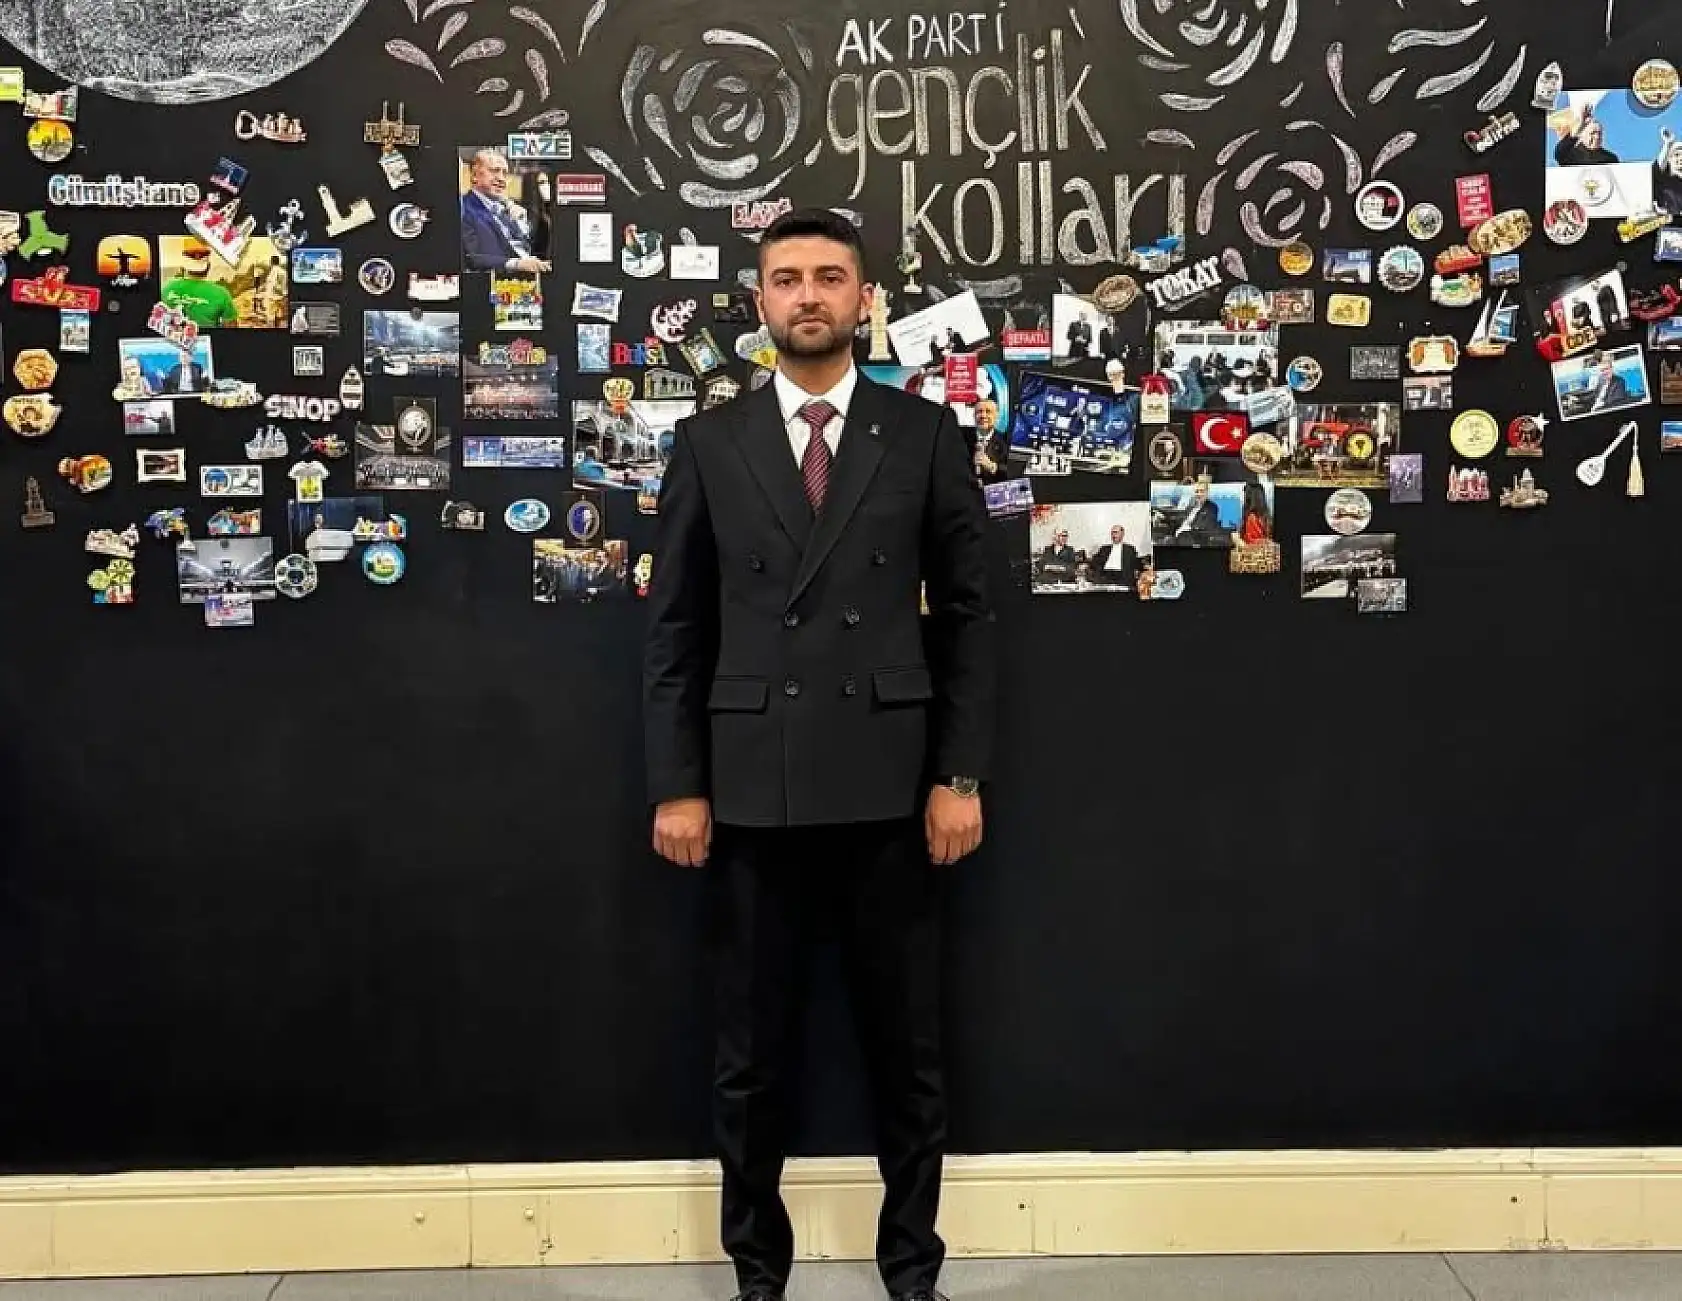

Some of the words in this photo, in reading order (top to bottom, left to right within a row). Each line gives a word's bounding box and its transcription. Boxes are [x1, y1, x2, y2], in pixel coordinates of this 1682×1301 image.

[836, 18, 894, 66] AK
[826, 28, 1108, 200] gençlik
[49, 174, 201, 206] Gümüşhane
[901, 159, 1187, 268] kolları
[1145, 255, 1222, 307] TOKAT
